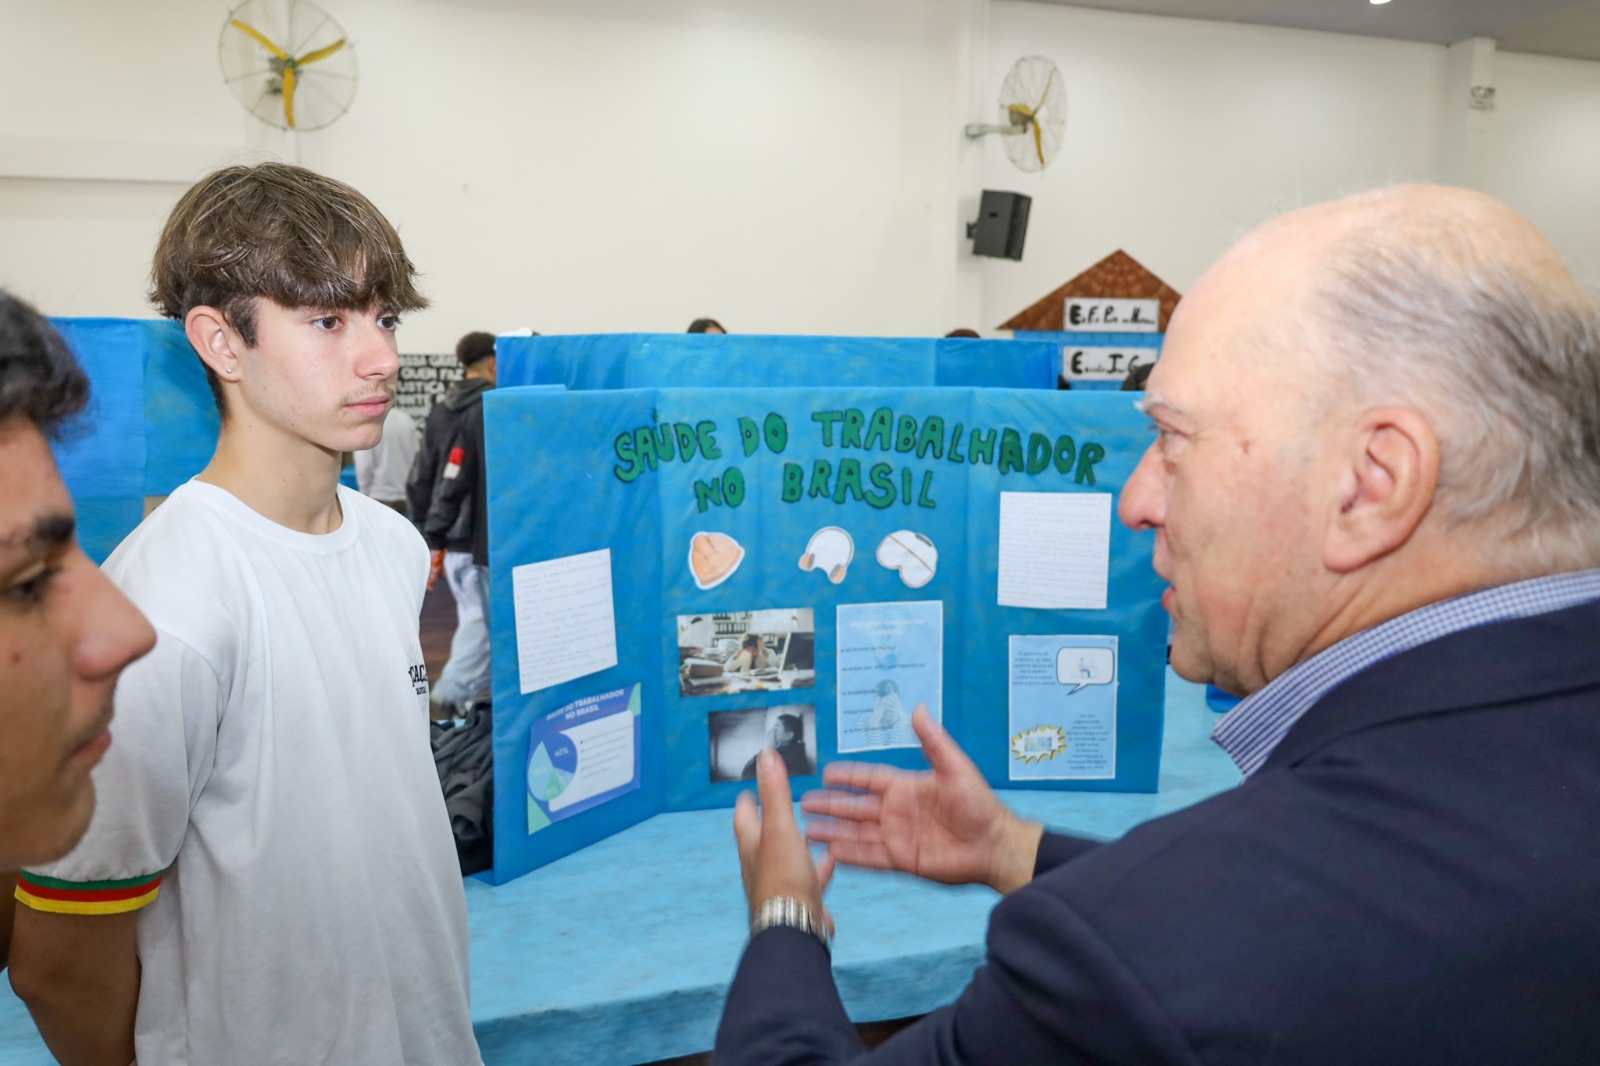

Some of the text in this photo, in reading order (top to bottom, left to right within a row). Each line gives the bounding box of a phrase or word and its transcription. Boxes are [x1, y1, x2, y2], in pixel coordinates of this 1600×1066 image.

[398, 381, 445, 393] USTIÇA
[737, 412, 788, 458] DO
[811, 407, 1106, 485] TRABALHADOR
[693, 458, 936, 514] NO BRASIL
[574, 688, 625, 709] TRABALHADOR
[565, 703, 600, 721] NO BRASIL
